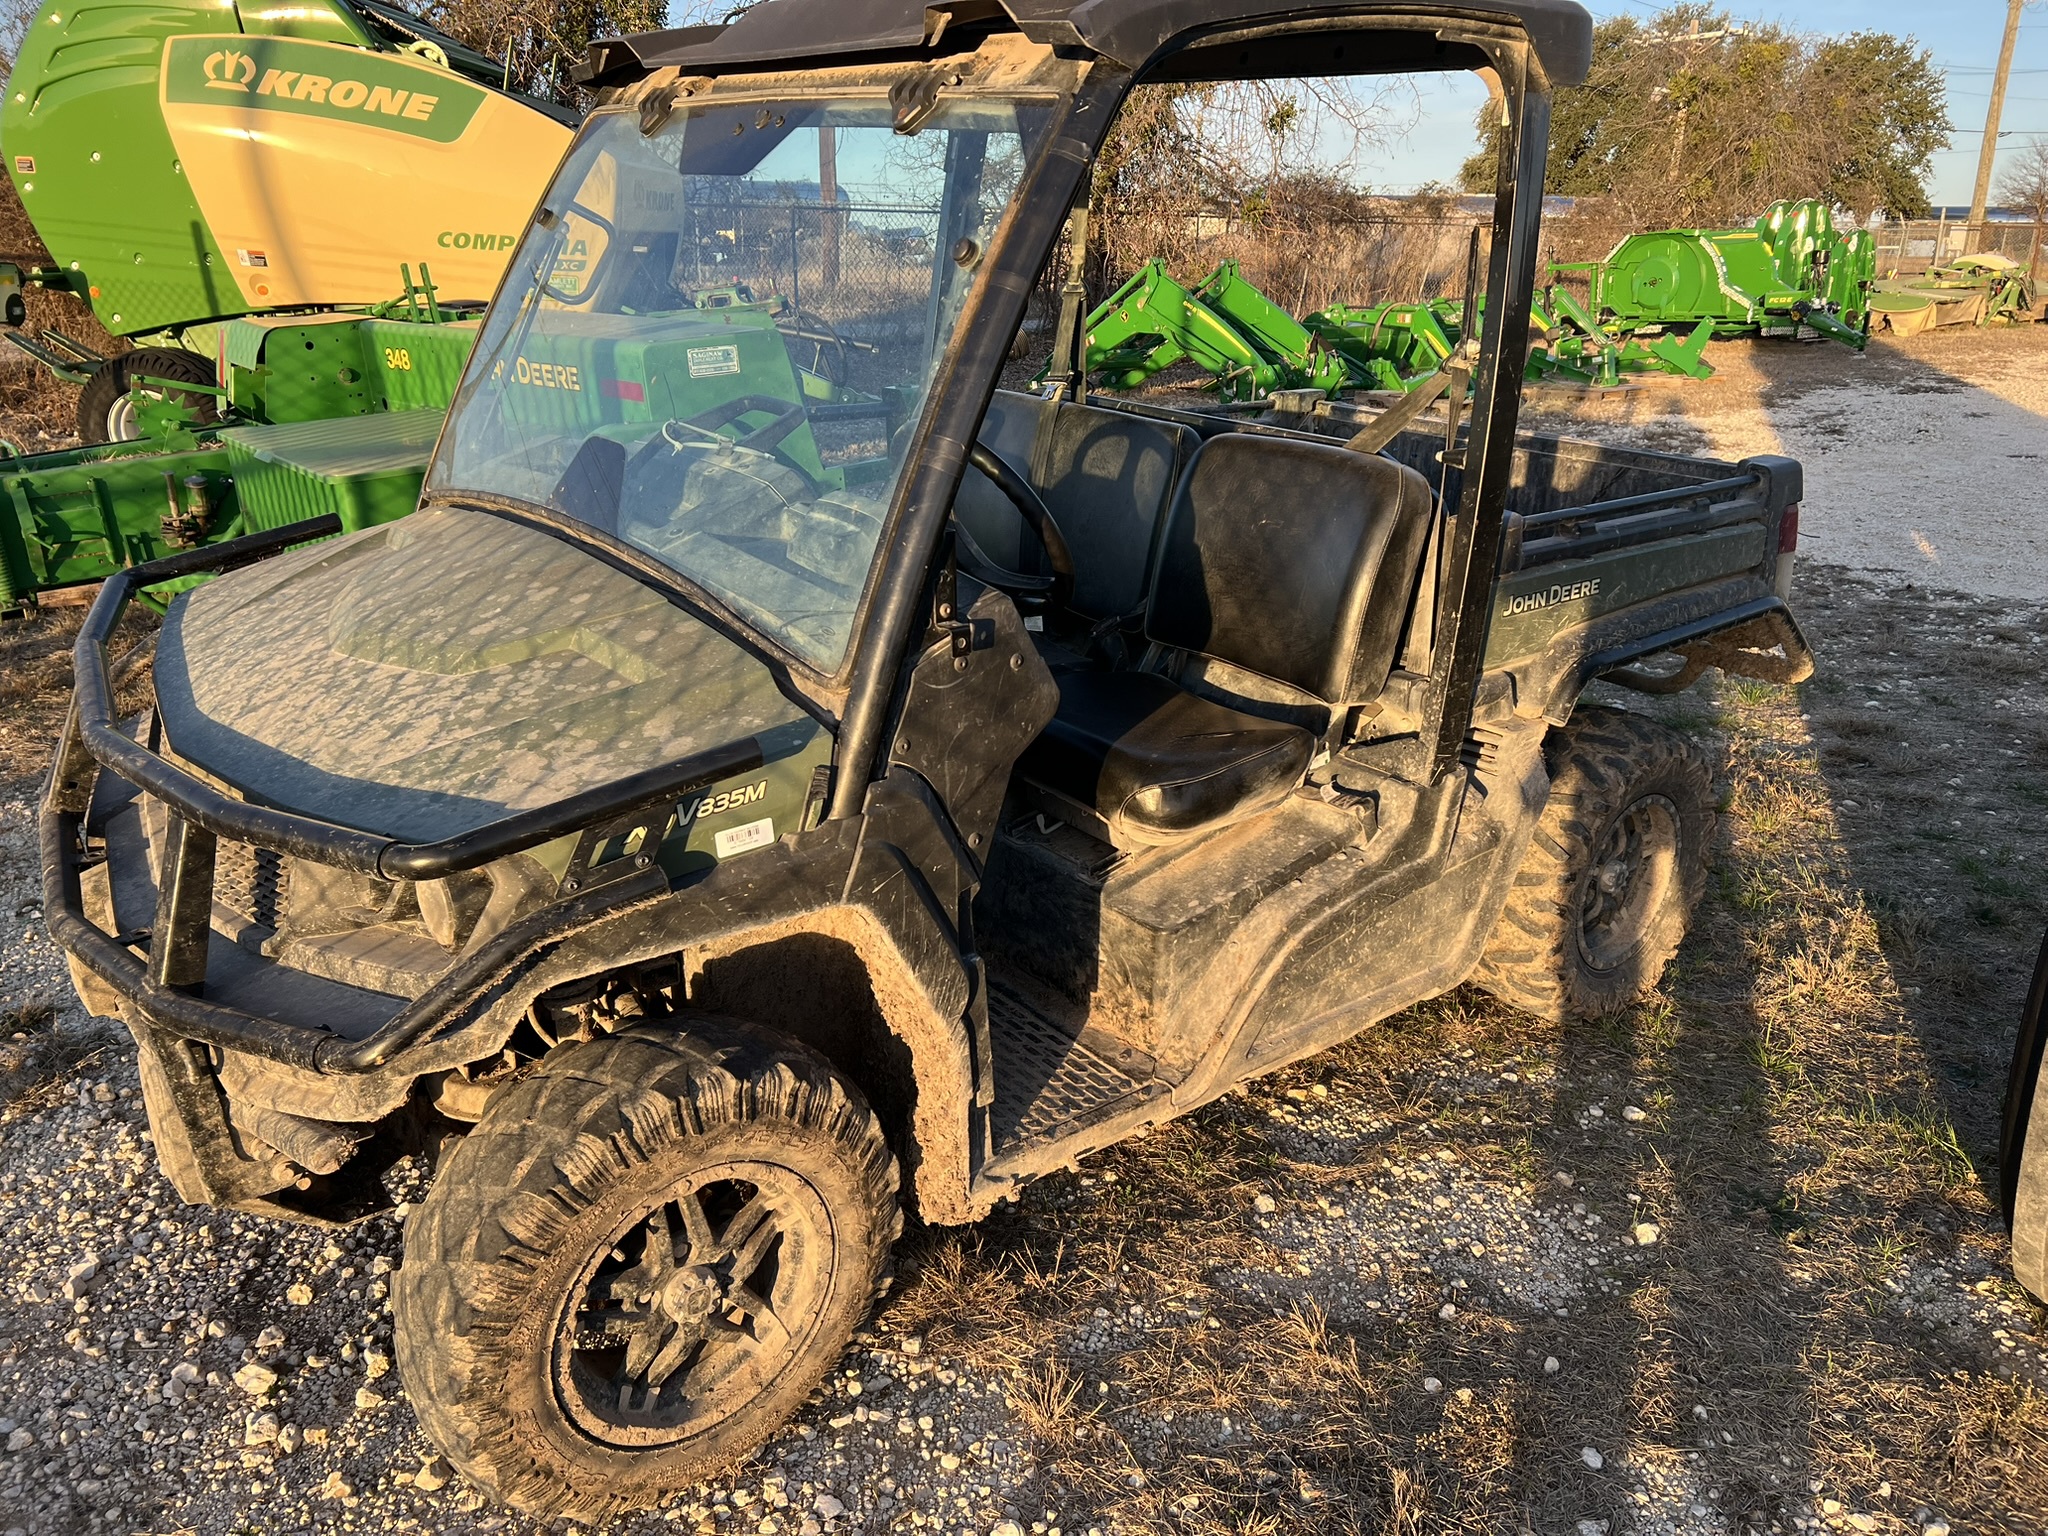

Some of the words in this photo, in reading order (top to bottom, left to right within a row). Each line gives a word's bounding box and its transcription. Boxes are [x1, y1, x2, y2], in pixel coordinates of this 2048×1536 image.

[256, 68, 439, 121] KRONE
[385, 347, 411, 371] 348
[692, 350, 723, 358] SAGINAW
[517, 355, 581, 391] DEERE
[1502, 591, 1547, 617] JOHN
[1549, 578, 1601, 605] DEERE
